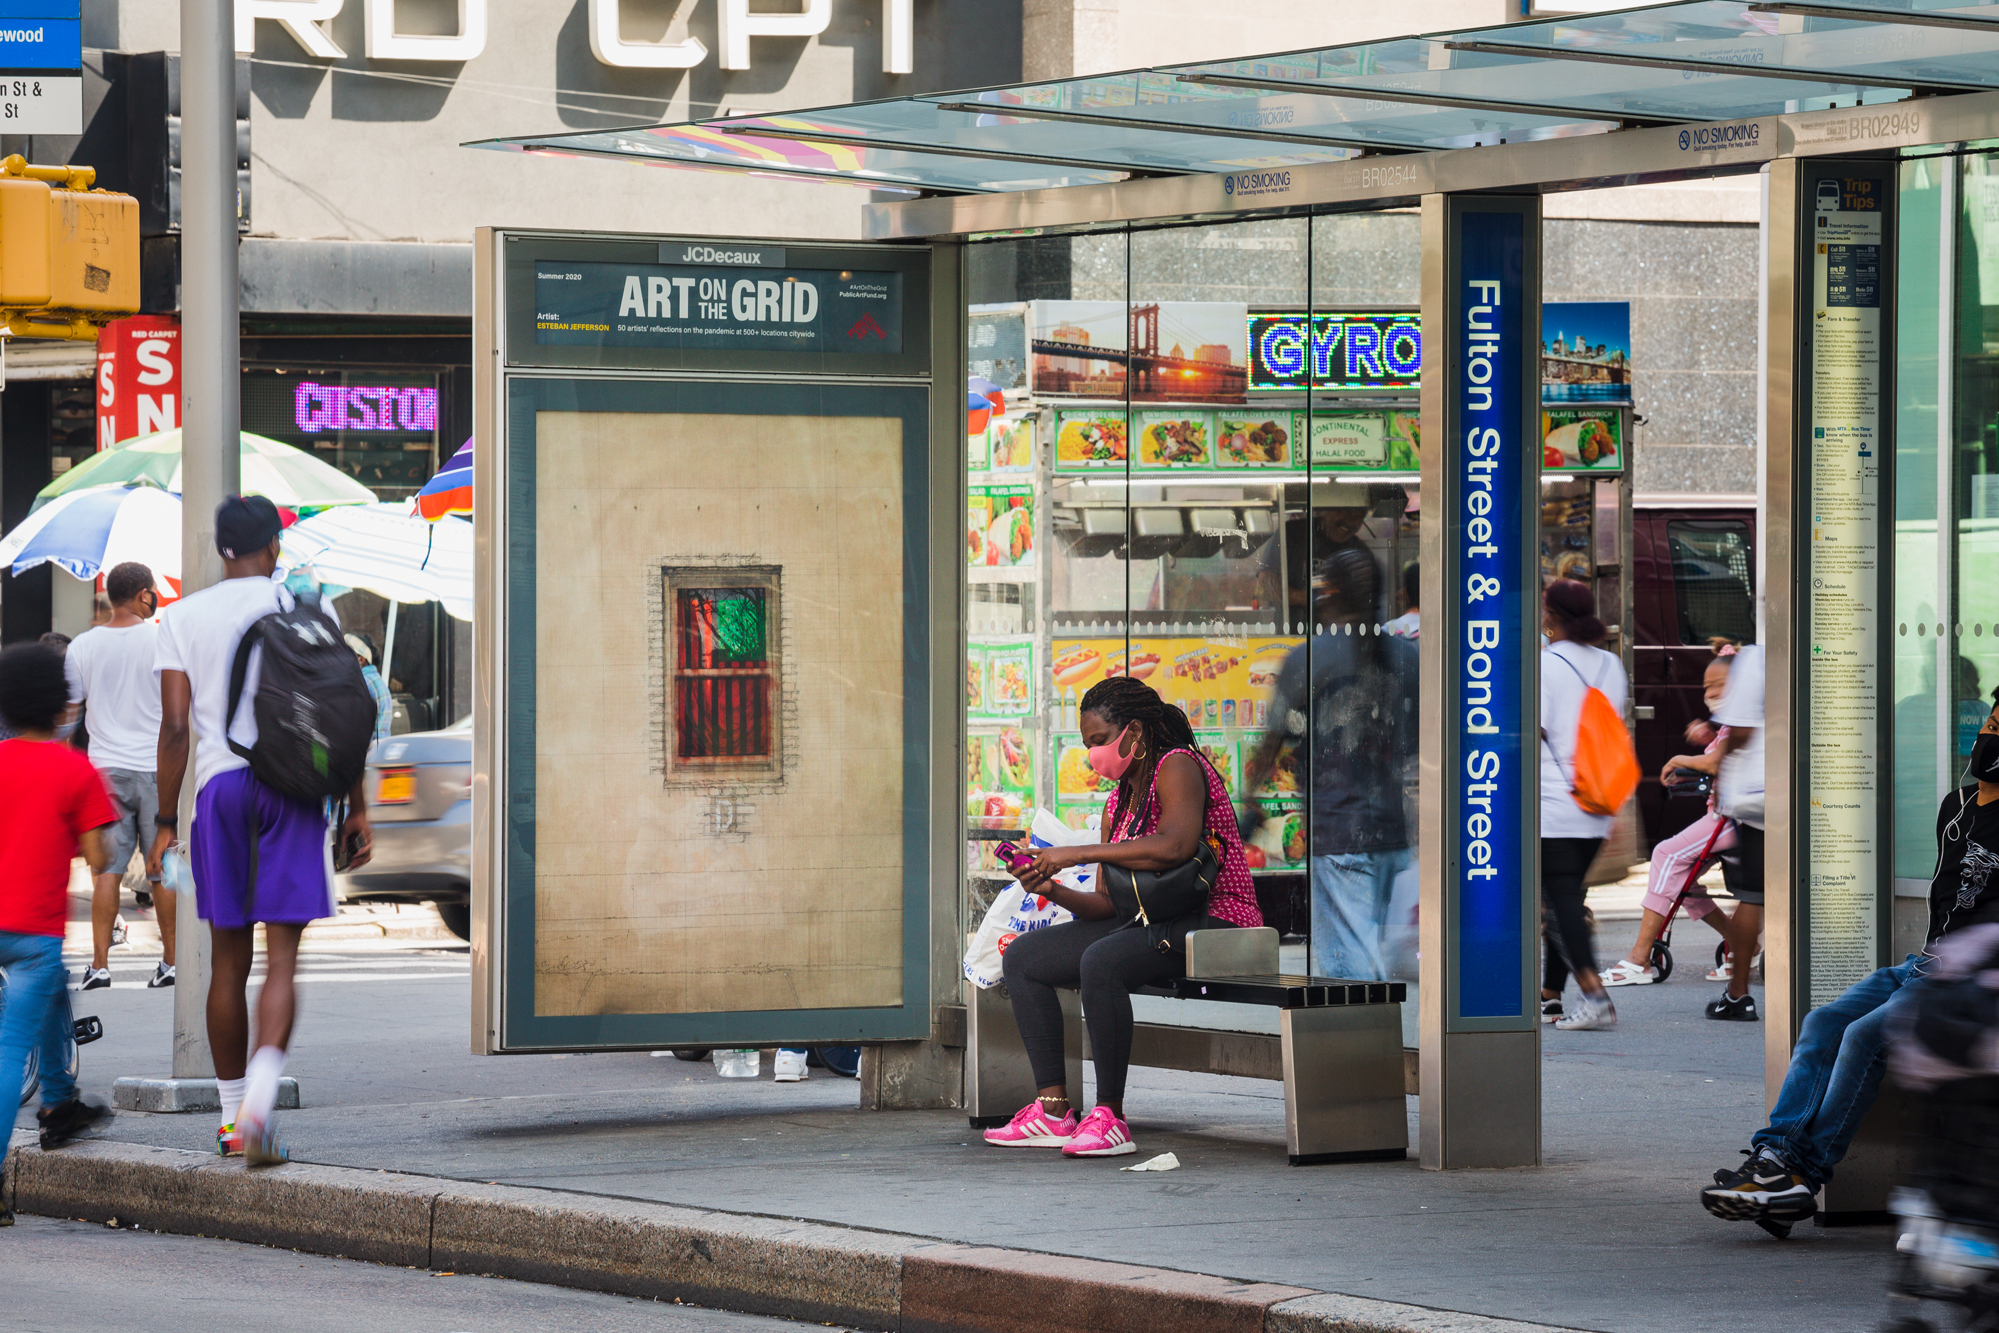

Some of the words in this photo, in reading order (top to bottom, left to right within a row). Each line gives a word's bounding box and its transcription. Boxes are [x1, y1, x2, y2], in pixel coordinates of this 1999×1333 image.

[13, 81, 26, 97] St
[33, 81, 42, 97] &
[5, 103, 18, 118] St
[1694, 129, 1709, 145] NO
[1711, 123, 1759, 143] SMOKING
[1838, 126, 1847, 134] 311
[1850, 112, 1920, 140] BR02949
[1237, 175, 1250, 190] NO
[1251, 171, 1290, 189] SMOKING
[1362, 164, 1416, 188] BR02544
[1844, 178, 1871, 194] Trip
[1843, 194, 1874, 211] Tips
[682, 247, 761, 265] JCDecaux
[538, 272, 564, 280] Summer
[618, 275, 696, 319] ART
[699, 278, 727, 301] ON
[839, 291, 887, 300] PublicArtFund.org
[731, 279, 819, 323] GRID
[537, 312, 560, 321] Artist:
[698, 302, 728, 320] THE
[148, 330, 178, 338] CARPET
[537, 322, 569, 330] ESTEBAN
[570, 323, 610, 331] JEFFERSON
[617, 324, 626, 332] 50
[650, 326, 683, 334] reflections
[705, 328, 735, 336] pandemic
[743, 328, 760, 336] 500+
[761, 329, 788, 337] locations
[789, 330, 815, 339] citywide
[1468, 280, 1501, 411] Fulton
[1218, 411, 1248, 419] FALAFEL
[1547, 410, 1576, 418] FALAFEL
[1322, 437, 1358, 445] EXPRESS
[1316, 449, 1341, 457] HALAL
[1343, 449, 1366, 457] FOOD
[1467, 427, 1501, 559] Street
[1467, 573, 1500, 604] &
[1467, 620, 1500, 734] Bond
[1960, 715, 1980, 725] NOW
[1467, 750, 1500, 880] Street
